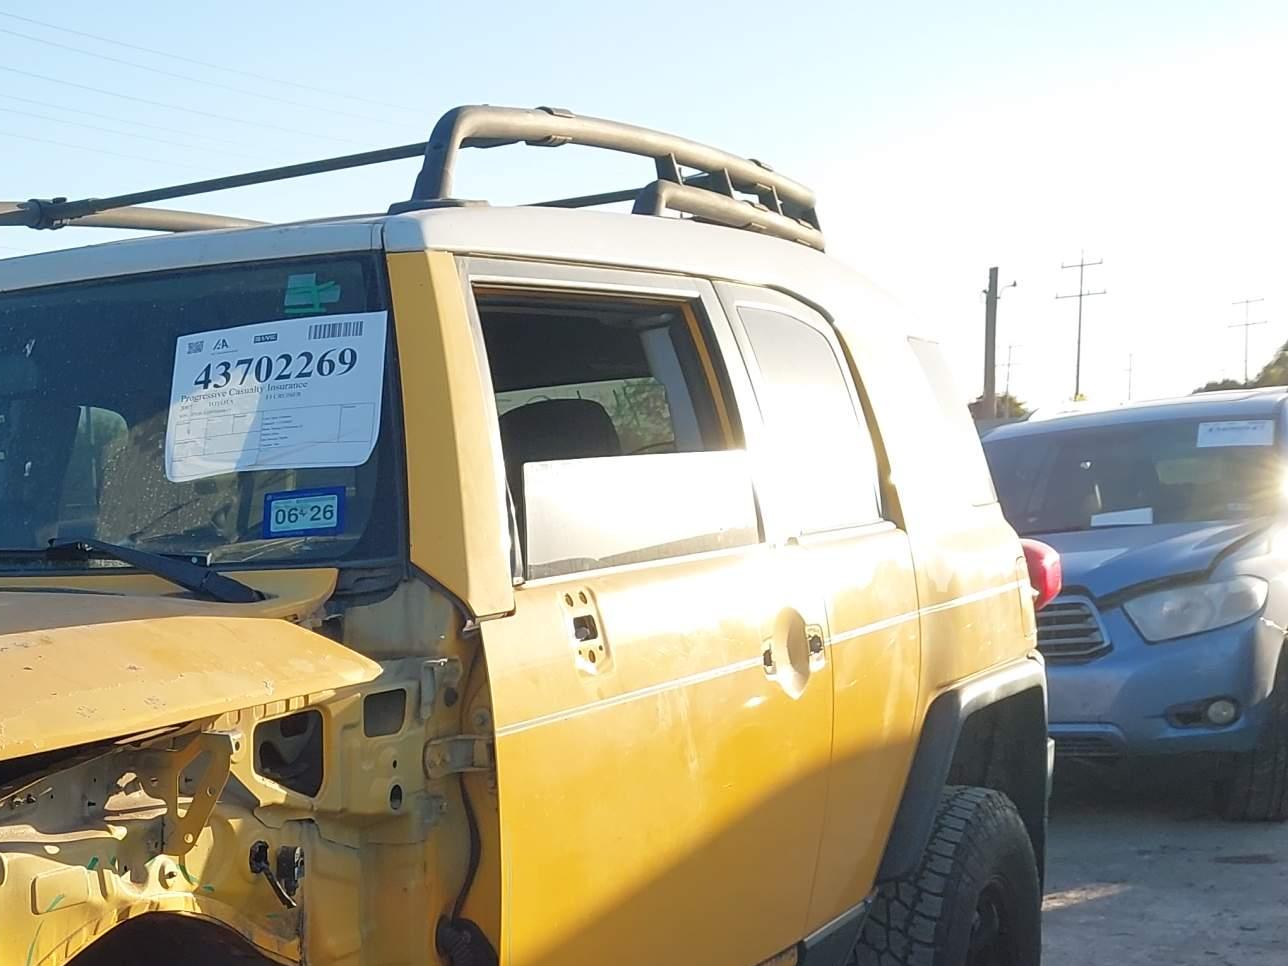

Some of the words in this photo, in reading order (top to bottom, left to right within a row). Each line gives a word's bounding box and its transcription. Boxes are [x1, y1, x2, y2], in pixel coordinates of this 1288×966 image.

[193, 347, 359, 391] 43702269
[180, 391, 228, 404] Progressive
[228, 385, 264, 397] Casualty
[267, 381, 309, 392] Insurance
[274, 507, 299, 525] 06
[310, 504, 334, 521] 26
